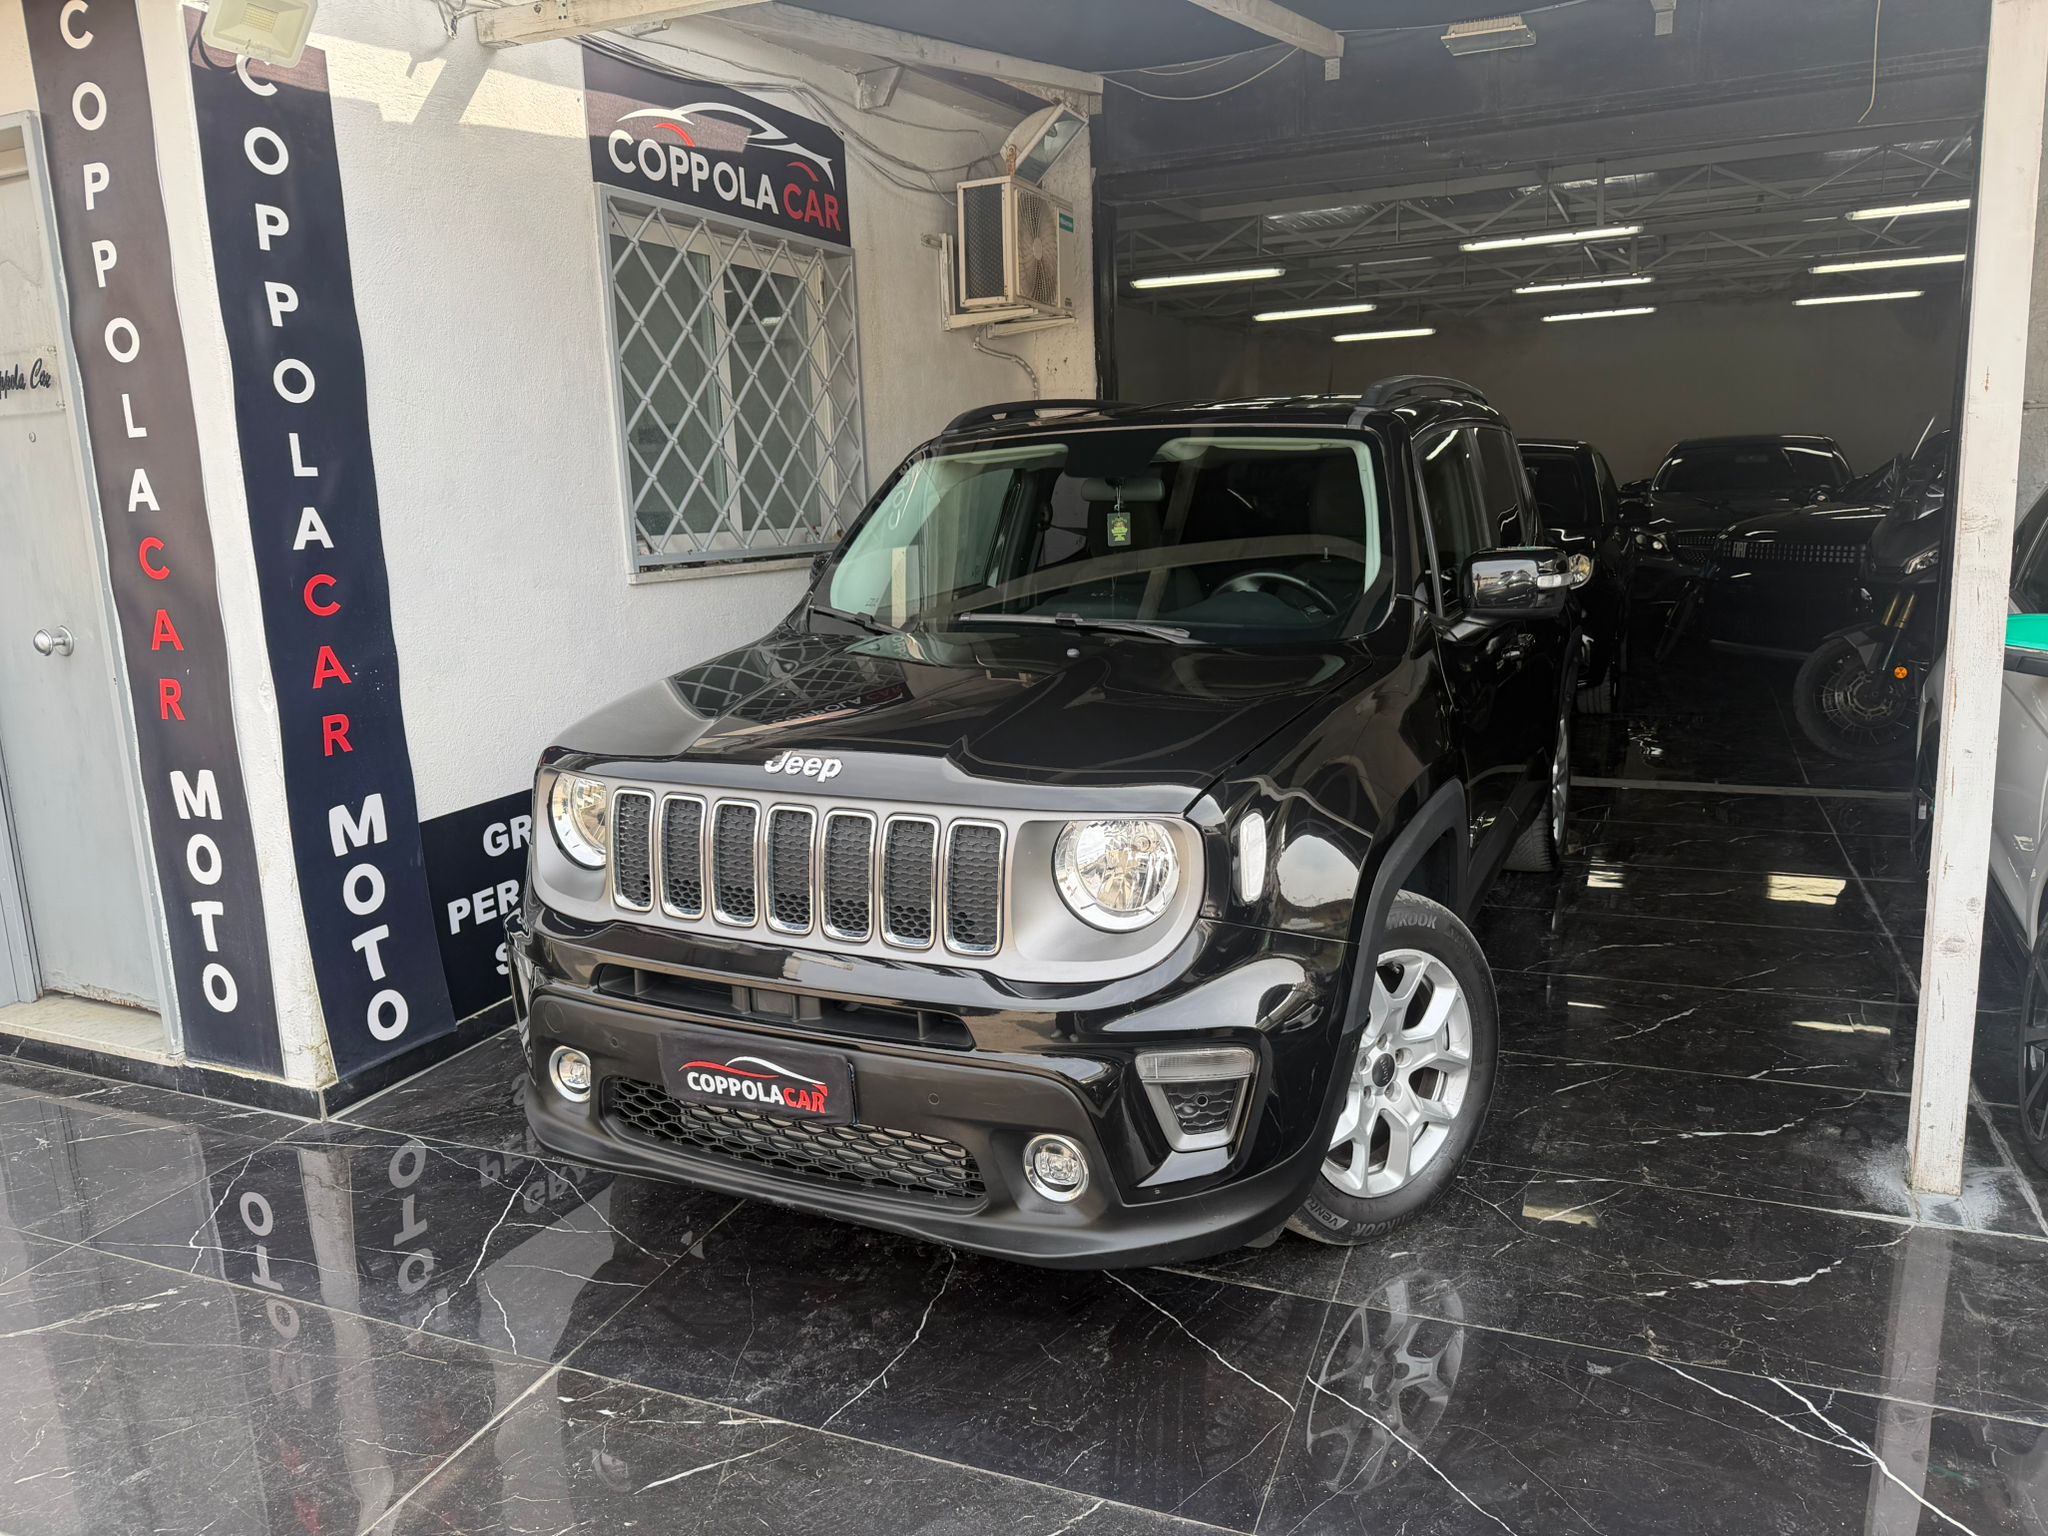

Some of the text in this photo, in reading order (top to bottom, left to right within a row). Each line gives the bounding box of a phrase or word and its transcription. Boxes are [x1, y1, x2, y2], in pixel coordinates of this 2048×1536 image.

[764, 750, 843, 783] Jeep
[170, 769, 239, 1013] MOTO
[328, 793, 409, 1042] MOTO
